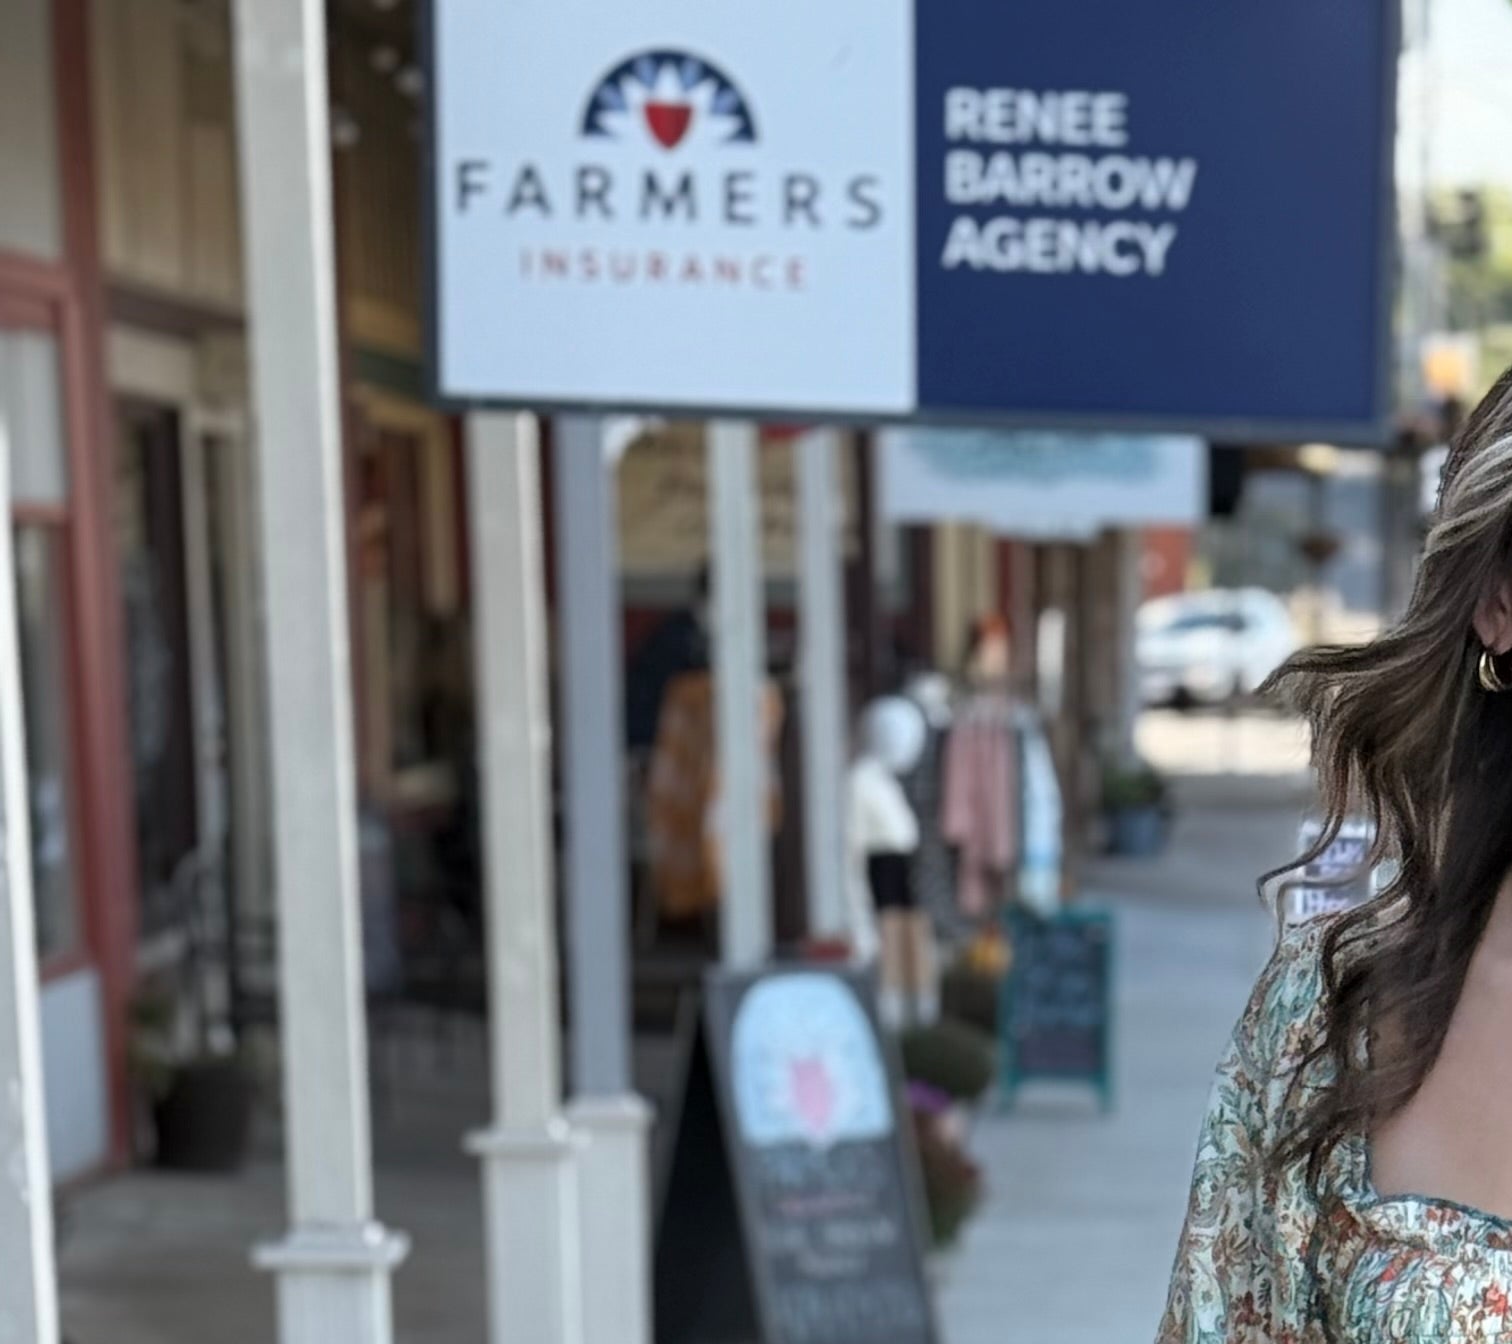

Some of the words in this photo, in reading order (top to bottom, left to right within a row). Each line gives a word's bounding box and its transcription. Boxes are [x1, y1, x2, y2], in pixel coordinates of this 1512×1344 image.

[943, 87, 1129, 148] RENEE
[453, 159, 884, 230] FARMERS
[943, 149, 1197, 210] BARROW
[520, 249, 808, 292] INSURANCE
[940, 217, 1178, 276] AGENCY
